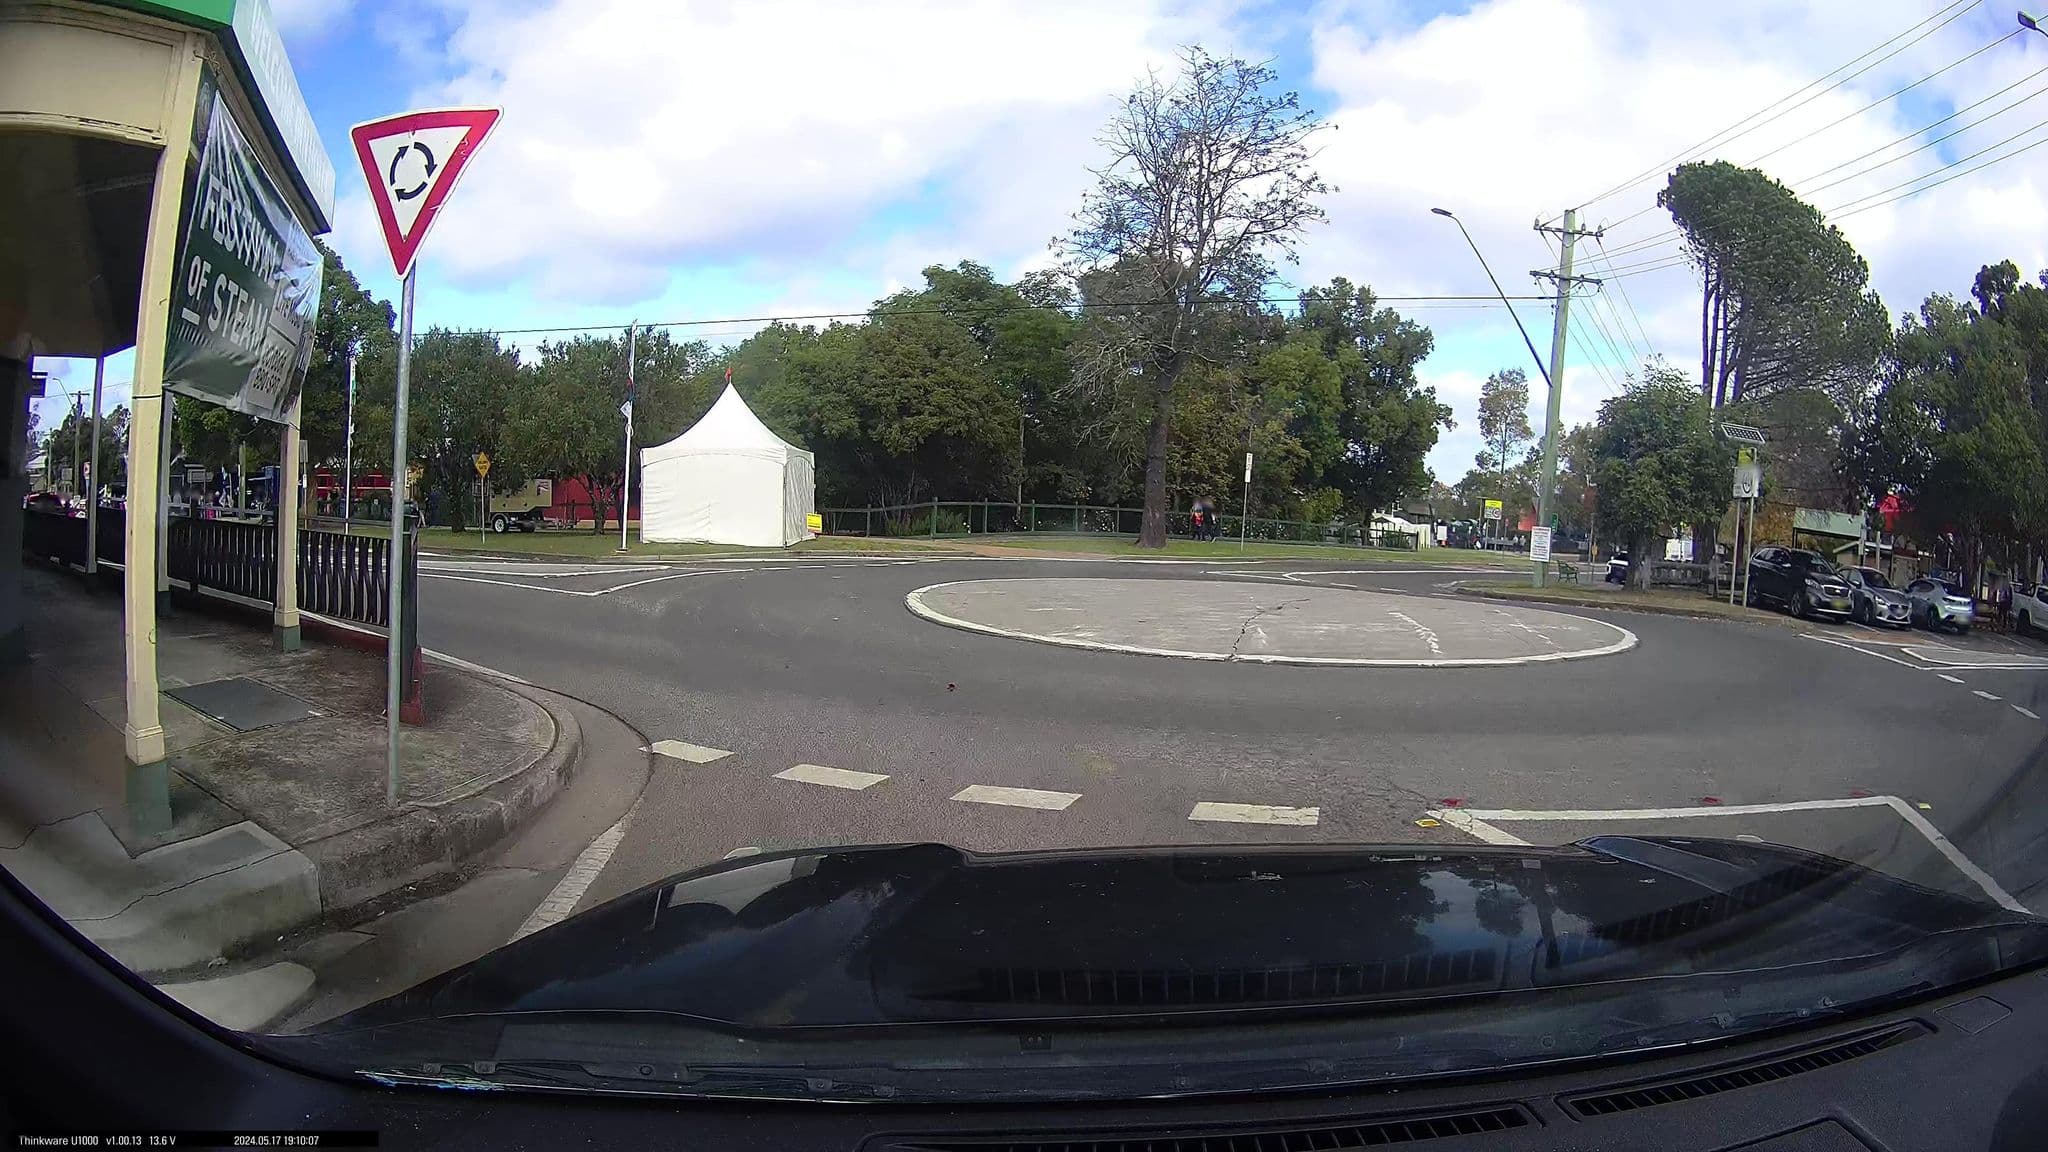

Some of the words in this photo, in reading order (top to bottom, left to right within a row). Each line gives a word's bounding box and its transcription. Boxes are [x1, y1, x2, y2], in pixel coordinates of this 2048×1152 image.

[200, 174, 279, 288] FESTIVAL
[187, 255, 212, 300] OF
[207, 273, 268, 356] STEAM
